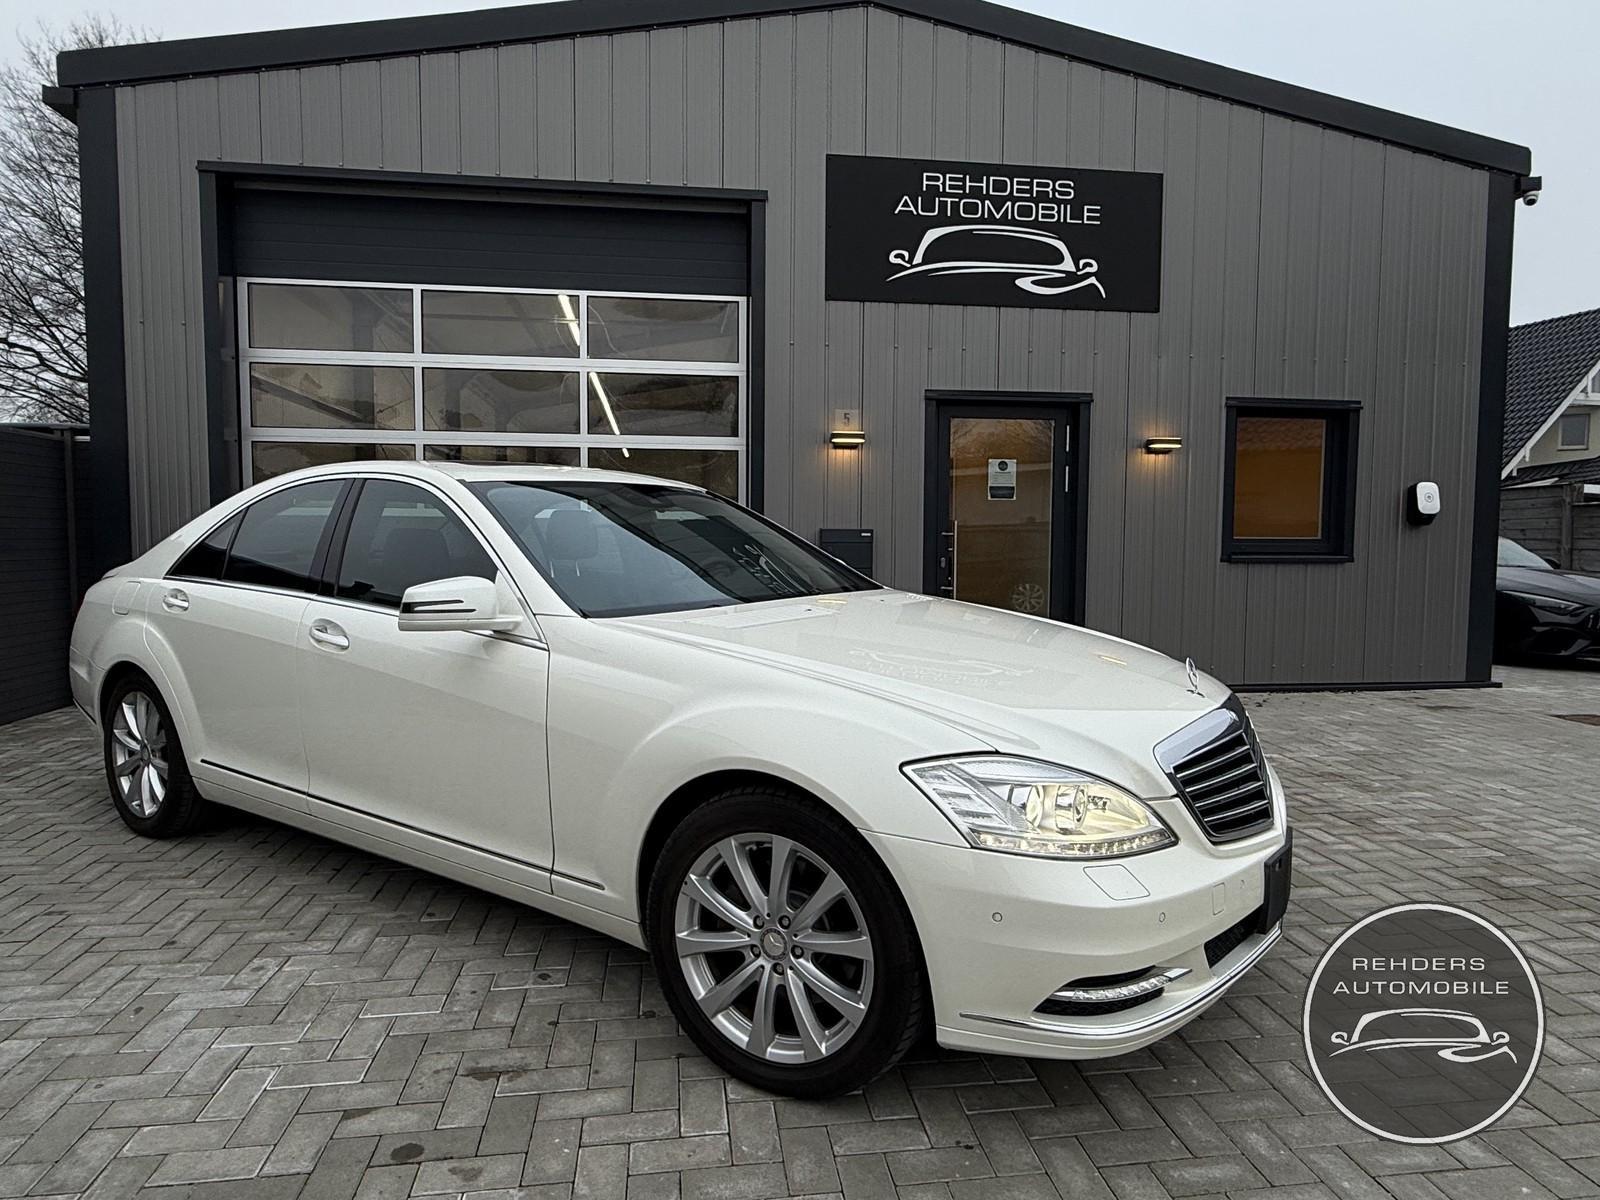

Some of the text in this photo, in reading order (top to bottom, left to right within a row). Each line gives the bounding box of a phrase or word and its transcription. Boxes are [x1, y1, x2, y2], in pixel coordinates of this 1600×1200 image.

[922, 172, 1075, 200] REHDERS
[894, 195, 1101, 225] AUTOMOBILE
[843, 412, 850, 426] 5
